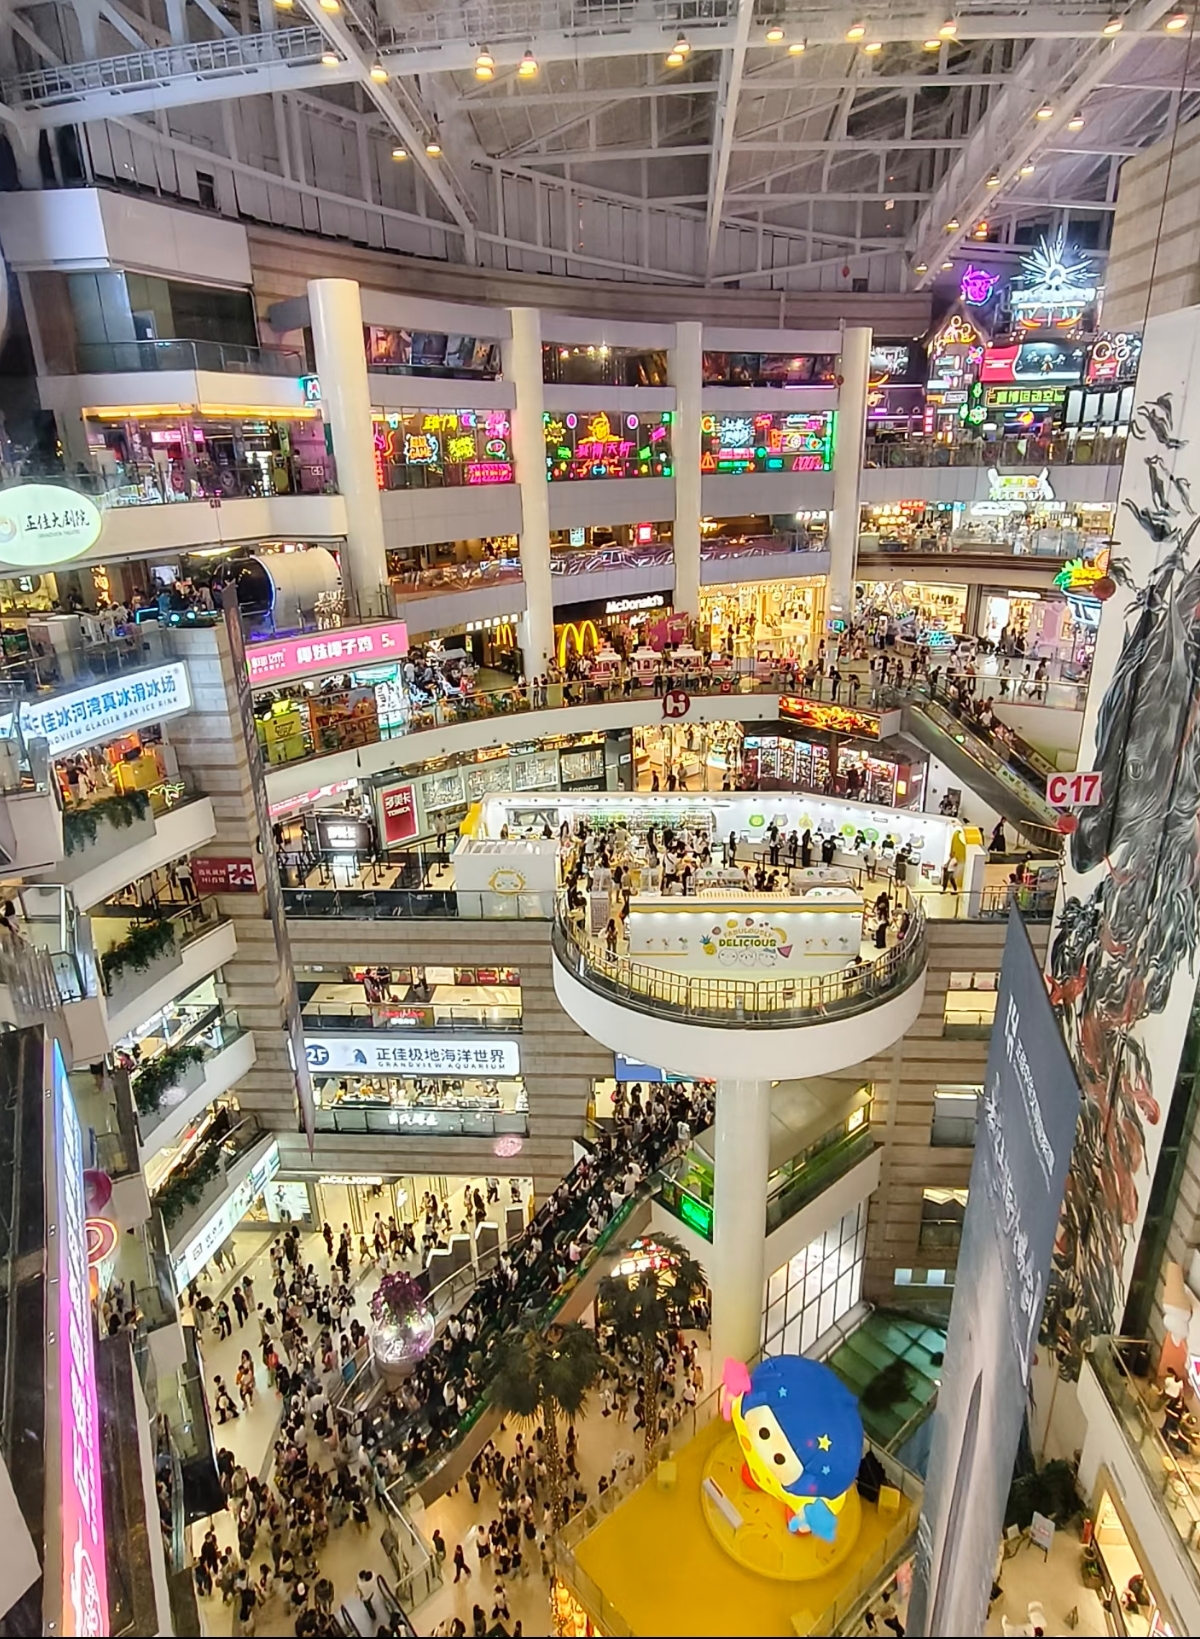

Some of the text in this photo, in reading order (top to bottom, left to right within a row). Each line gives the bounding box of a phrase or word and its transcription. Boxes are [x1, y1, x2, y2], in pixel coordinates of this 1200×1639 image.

[25, 509, 90, 531] 正佳大剧院
[605, 595, 664, 614] McDonald's
[85, 715, 121, 732] GLACIER
[123, 708, 140, 720] BAY
[142, 702, 156, 713] ICE
[158, 696, 178, 708] RINK
[1050, 775, 1100, 804] C17
[385, 791, 412, 810] 多美卡
[387, 806, 411, 818] TOMICA
[723, 927, 773, 938] FABULOUSLY
[719, 938, 777, 948] DELICIOUS
[376, 1047, 505, 1063] 正佳极地海洋世界
[378, 1061, 442, 1069] GRANDVIEW
